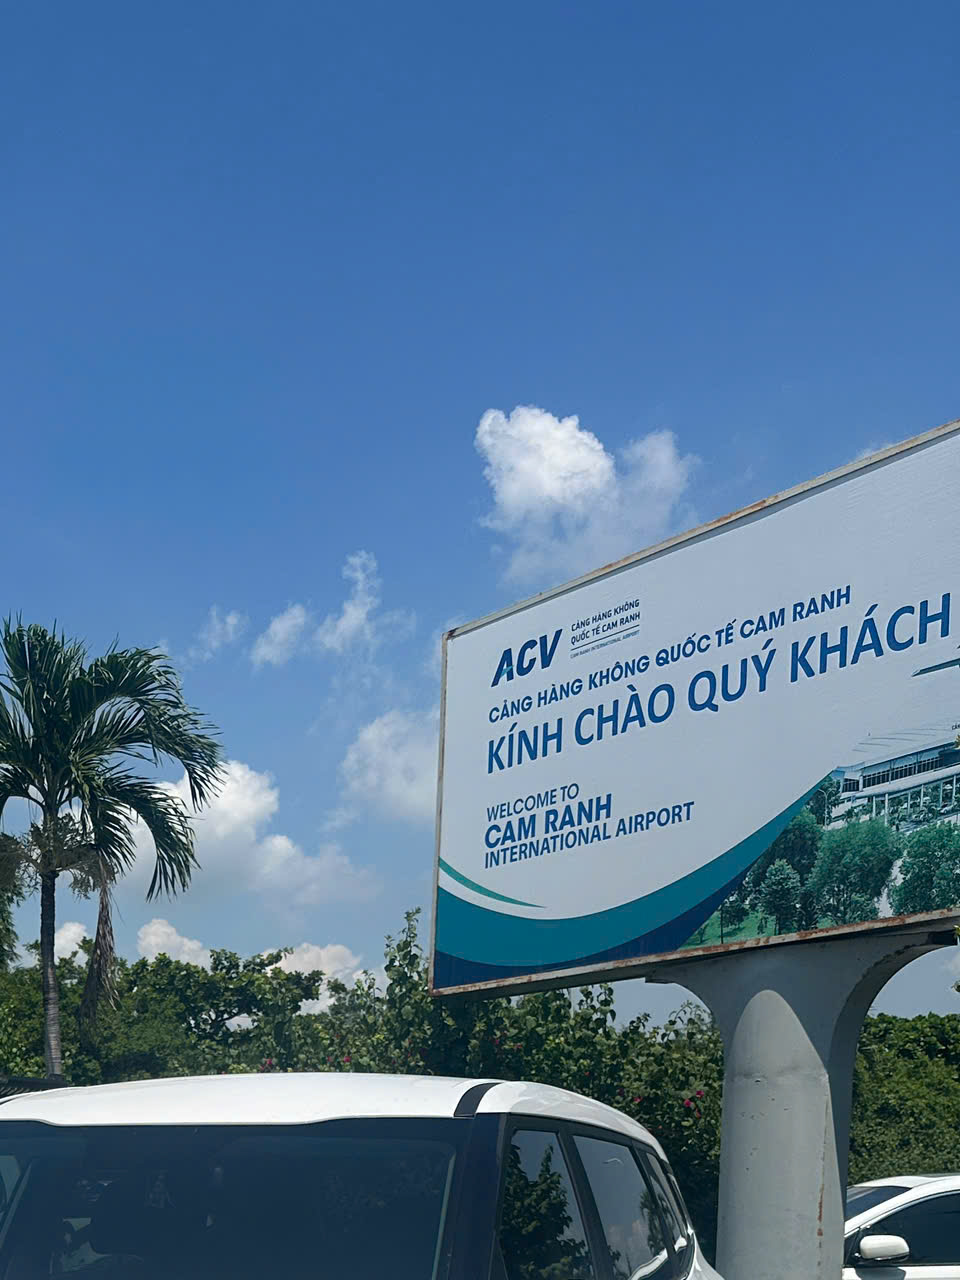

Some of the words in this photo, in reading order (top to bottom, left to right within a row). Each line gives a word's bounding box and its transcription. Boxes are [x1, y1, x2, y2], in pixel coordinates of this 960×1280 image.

[571, 618, 590, 632] CẢNG
[613, 598, 640, 616] KHÔNG
[571, 629, 590, 646] QUỐC
[602, 620, 618, 633] CAM
[620, 611, 640, 626] RANH
[488, 695, 533, 723] CẢNG
[537, 678, 583, 708] HÀNG
[588, 655, 650, 690] KHÔNG
[655, 632, 711, 667] QUỐC
[715, 618, 737, 648] TẾ
[740, 608, 786, 639] CAM
[792, 585, 851, 622] RANH
[491, 628, 563, 688] ACV
[487, 722, 563, 775] KÍNH
[574, 683, 676, 746] CHÀO
[688, 637, 777, 713] QUÝ
[790, 592, 952, 683] KHÁCH
[484, 814, 537, 849] CAM
[544, 793, 612, 834] RANH
[486, 788, 557, 822] WELCOME
[560, 782, 580, 802] TO
[484, 822, 612, 869] INTERNATIONAL
[615, 801, 695, 838] AIRPORT
